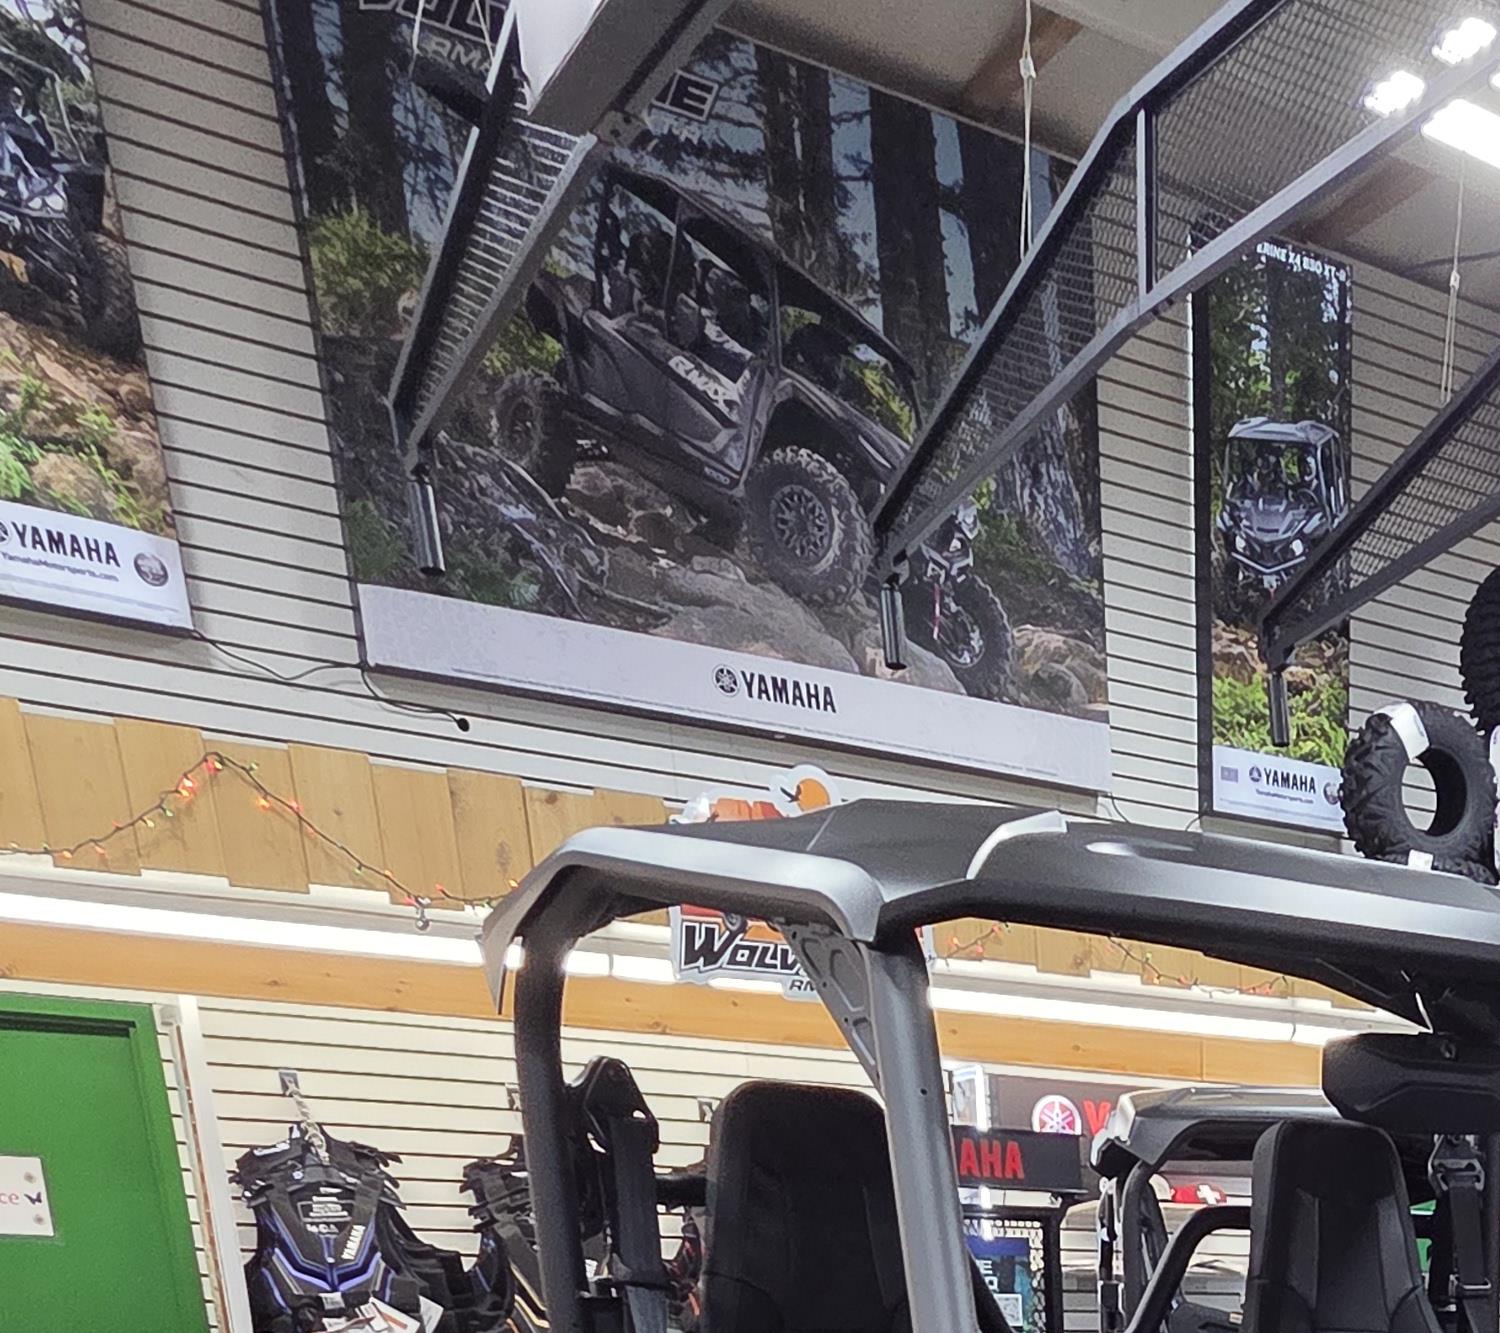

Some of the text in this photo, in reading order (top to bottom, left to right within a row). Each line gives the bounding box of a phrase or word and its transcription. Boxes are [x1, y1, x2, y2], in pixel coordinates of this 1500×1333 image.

[12, 521, 121, 568] YAMAHA
[740, 669, 837, 714] YAMAHA
[1263, 767, 1317, 794] YAMAHA
[681, 919, 801, 976] WOLV
[960, 1139, 1024, 1179] AHA
